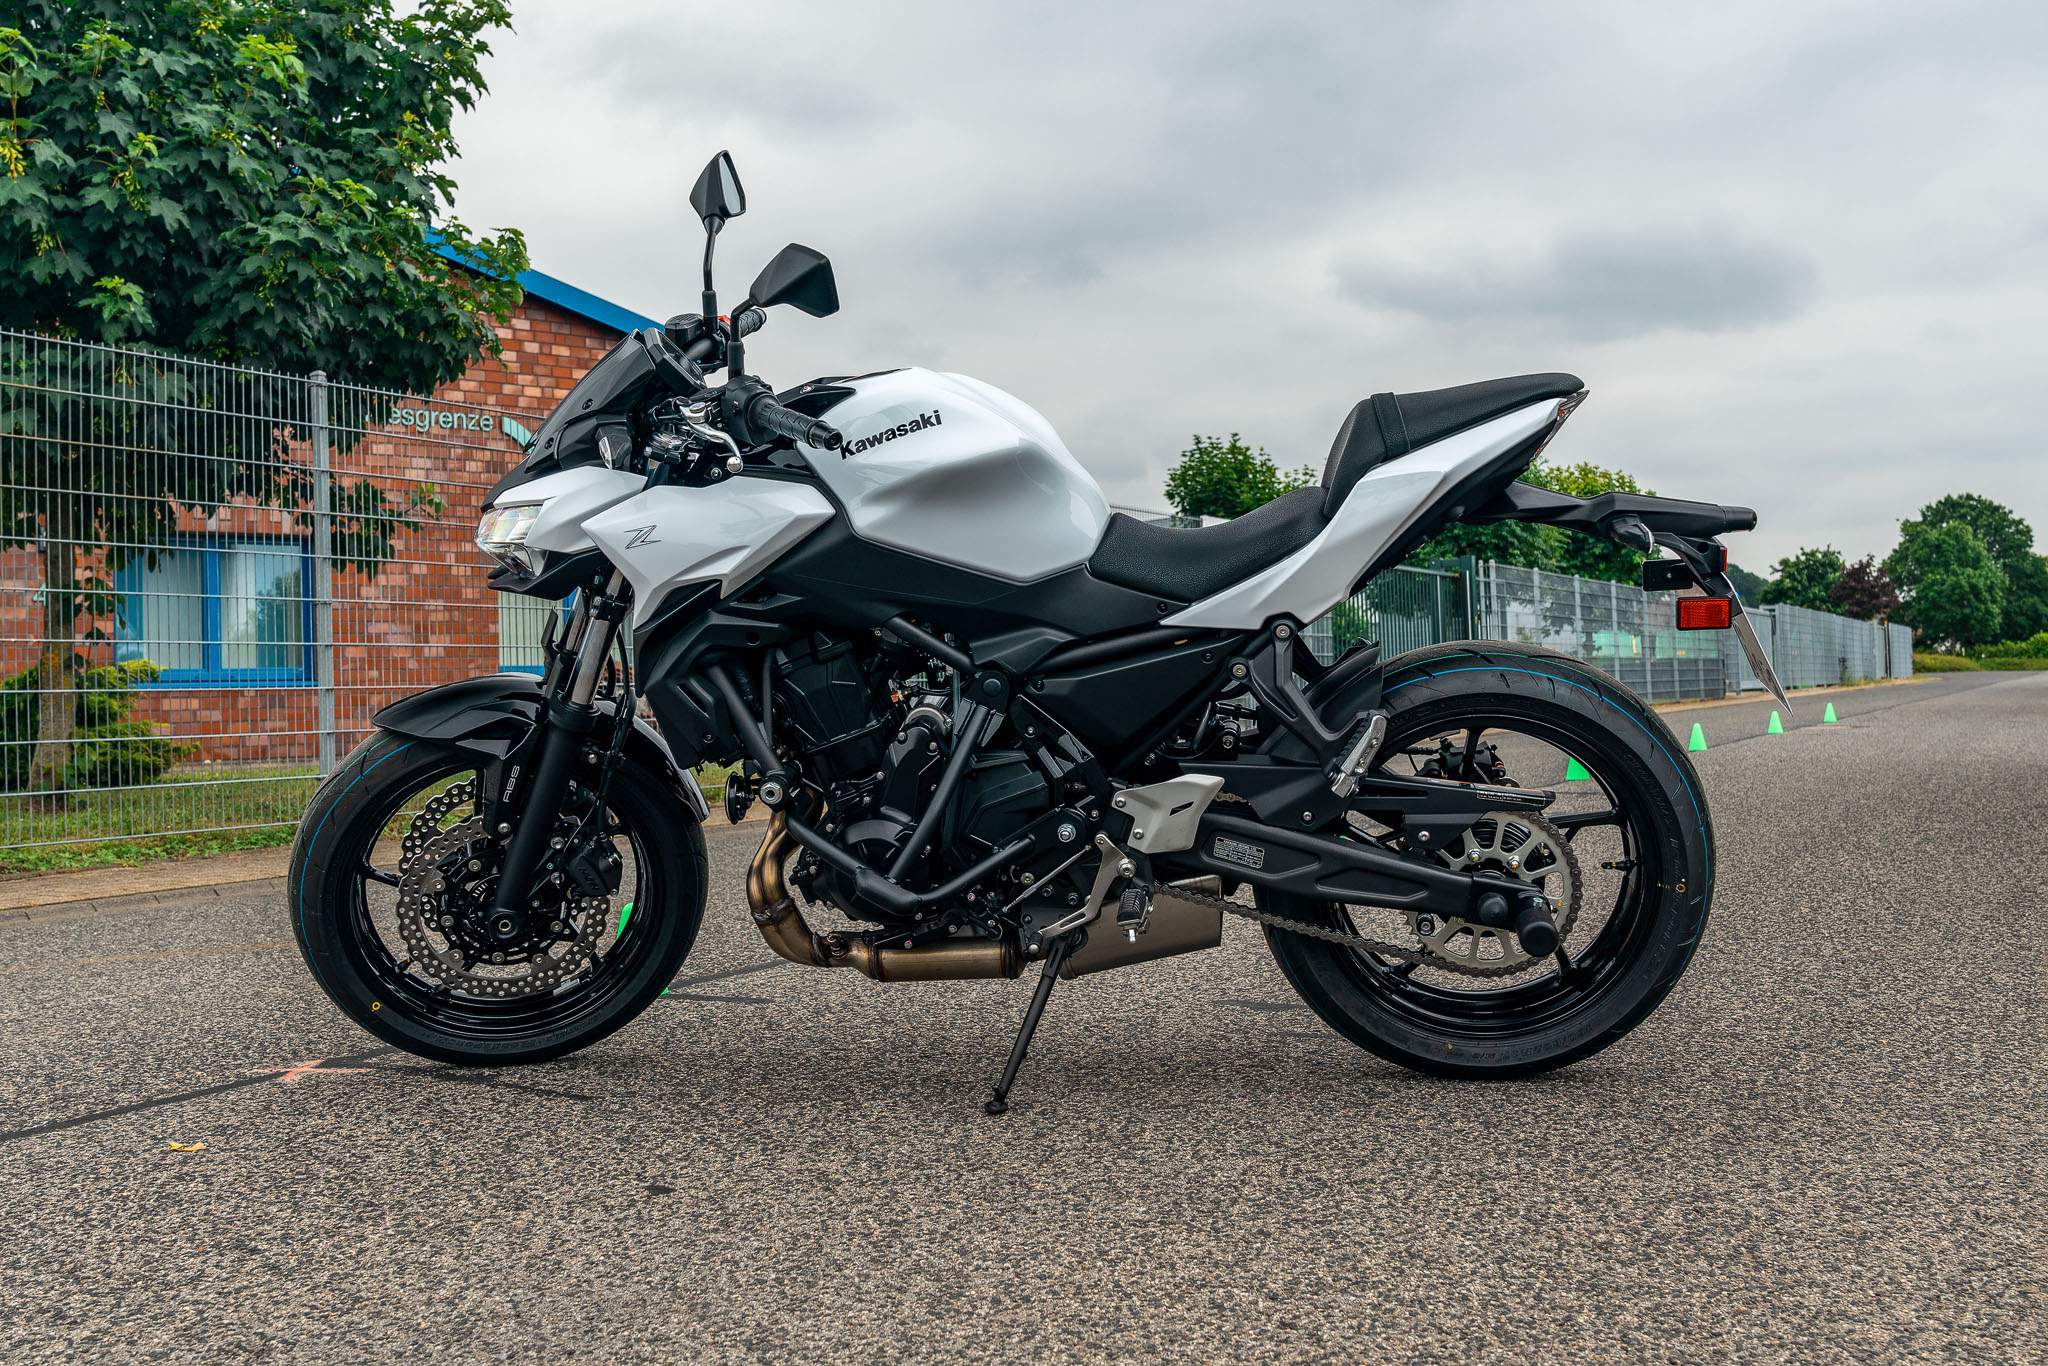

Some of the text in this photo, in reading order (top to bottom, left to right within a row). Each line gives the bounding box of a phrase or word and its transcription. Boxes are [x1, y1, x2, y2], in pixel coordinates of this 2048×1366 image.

[365, 407, 494, 432] esgrenze
[840, 409, 942, 460] Kawasaki
[502, 765, 520, 803] ABS
